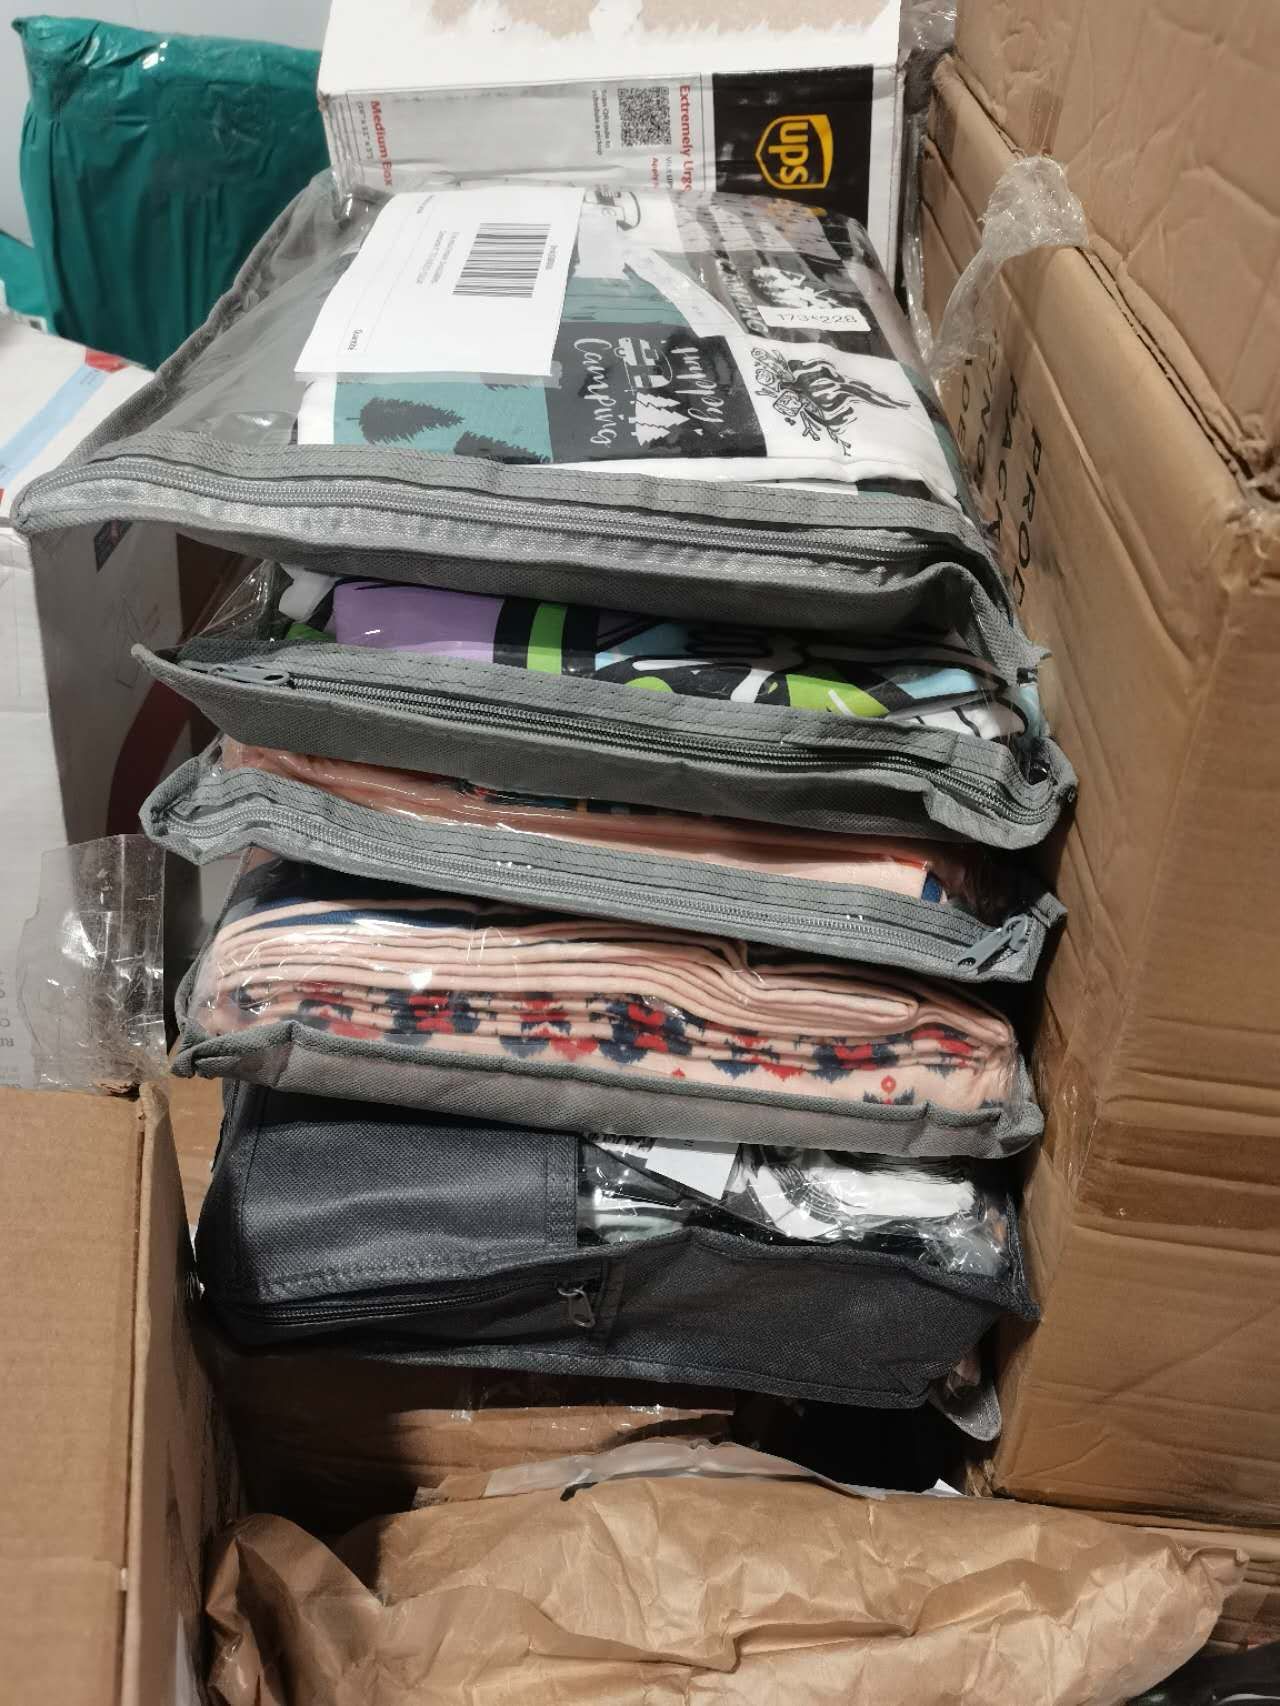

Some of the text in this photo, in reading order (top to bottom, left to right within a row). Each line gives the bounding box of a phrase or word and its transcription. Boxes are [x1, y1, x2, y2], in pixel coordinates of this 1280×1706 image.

[371, 100, 392, 186] Medium Box
[680, 85, 693, 157] Extremely
[574, 337, 617, 447] Camping
[670, 346, 724, 423] Happy
